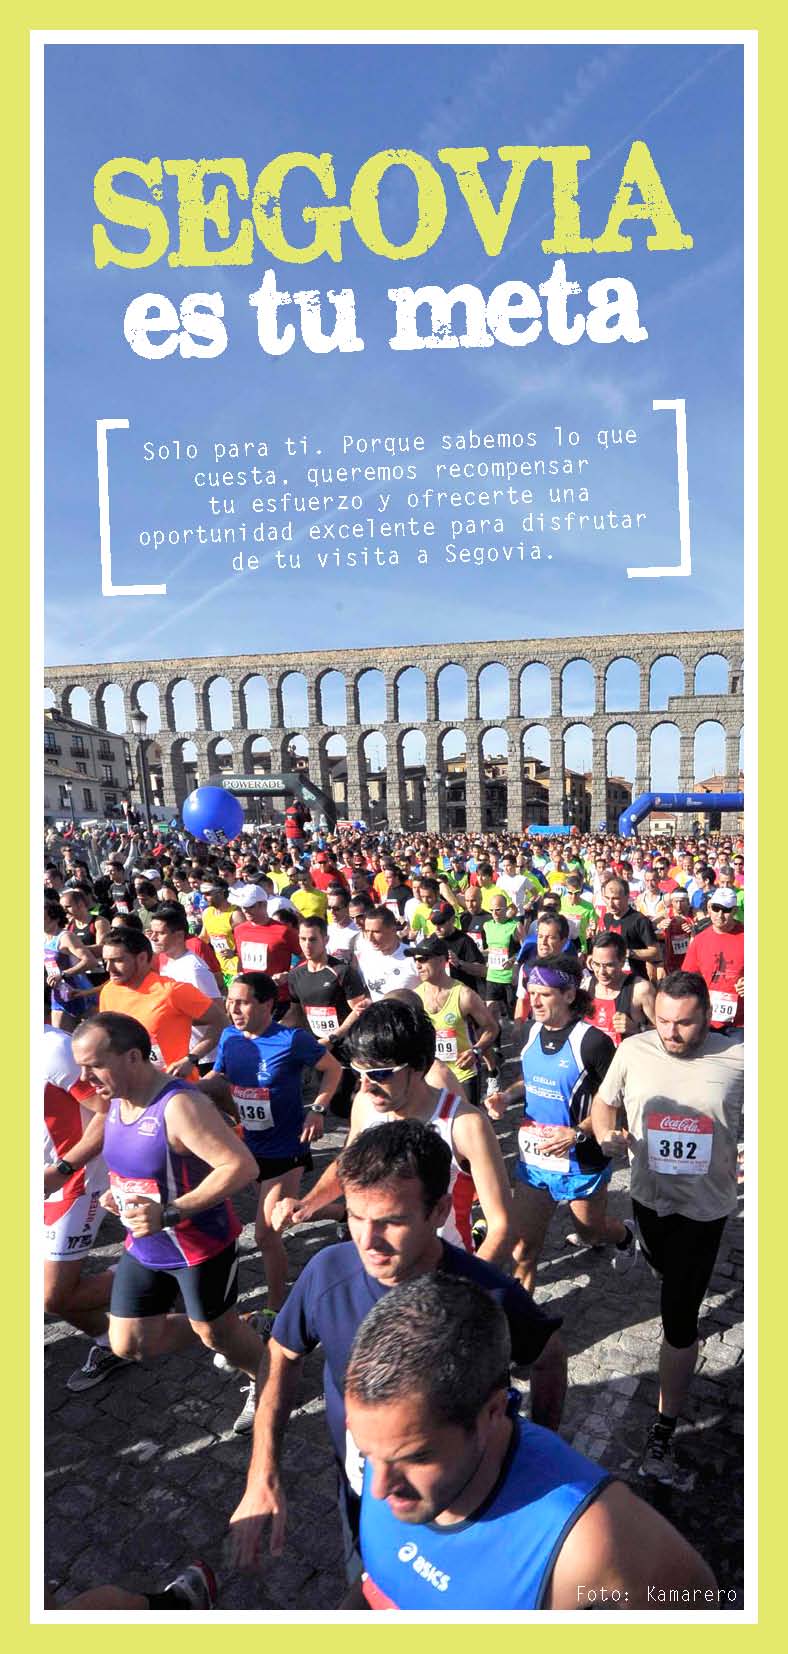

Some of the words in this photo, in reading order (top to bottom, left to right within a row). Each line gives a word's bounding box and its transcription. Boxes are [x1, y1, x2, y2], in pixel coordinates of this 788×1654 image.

[223, 780, 283, 790] POWERADE
[437, 1042, 453, 1053] 09
[659, 1139, 698, 1160] 382
